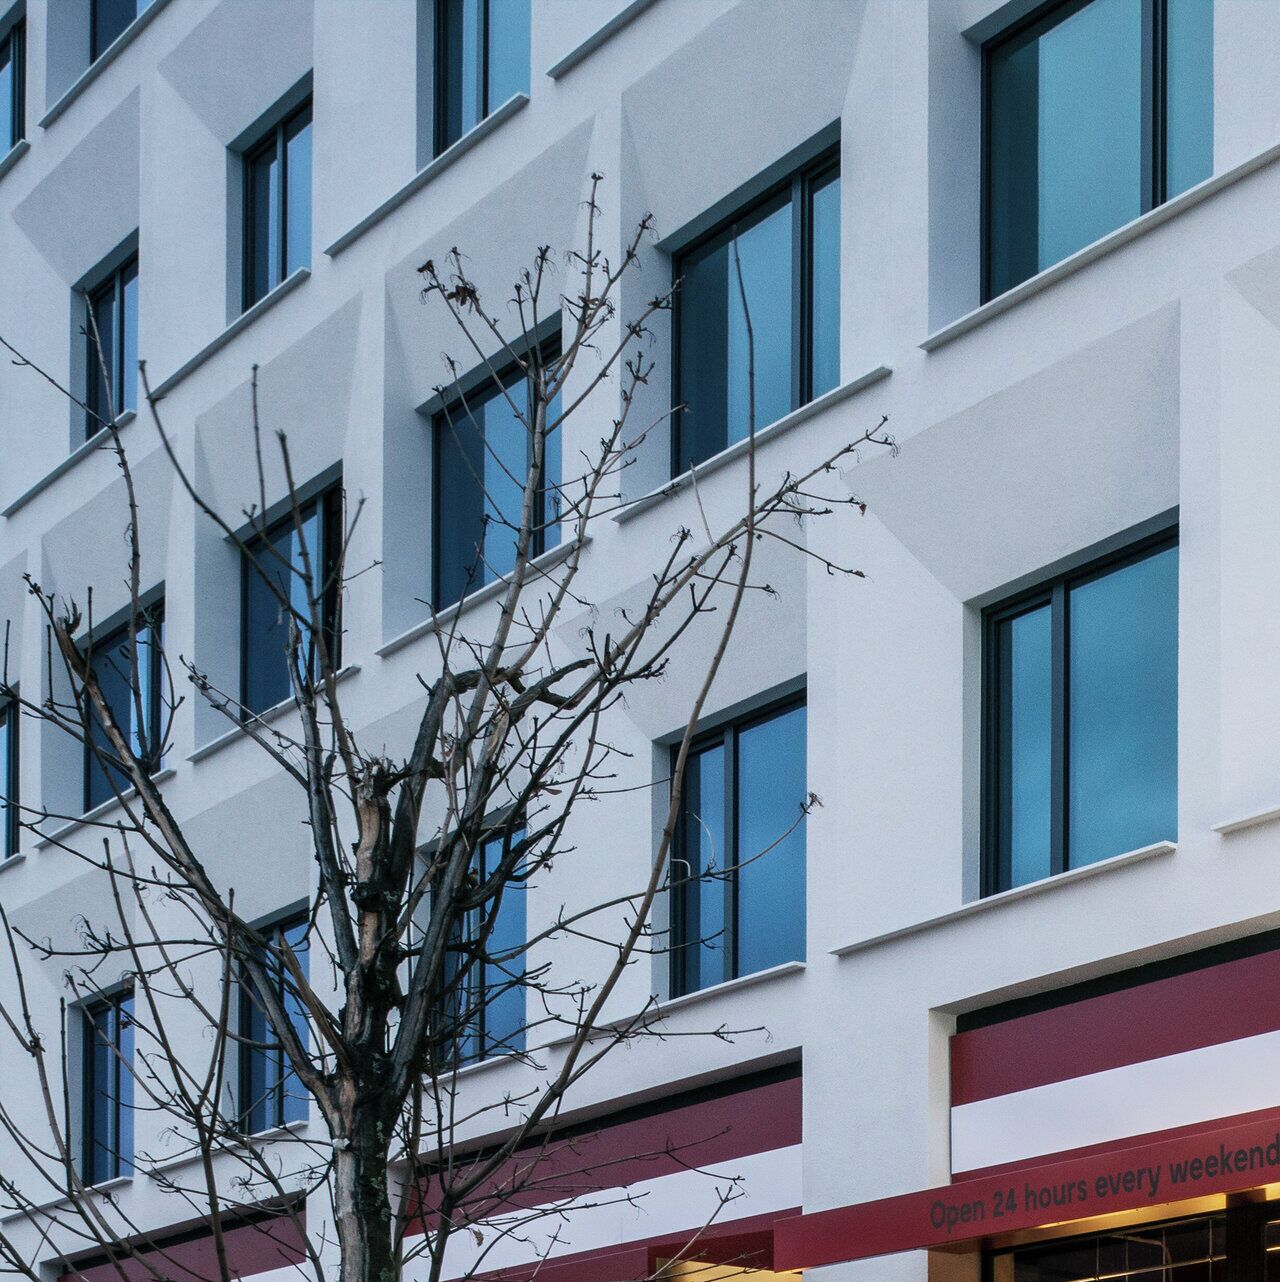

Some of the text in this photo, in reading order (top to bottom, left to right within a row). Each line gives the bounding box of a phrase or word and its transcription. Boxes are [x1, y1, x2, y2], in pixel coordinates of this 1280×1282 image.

[930, 1132, 1280, 1232] Open 24 hours every weekend
